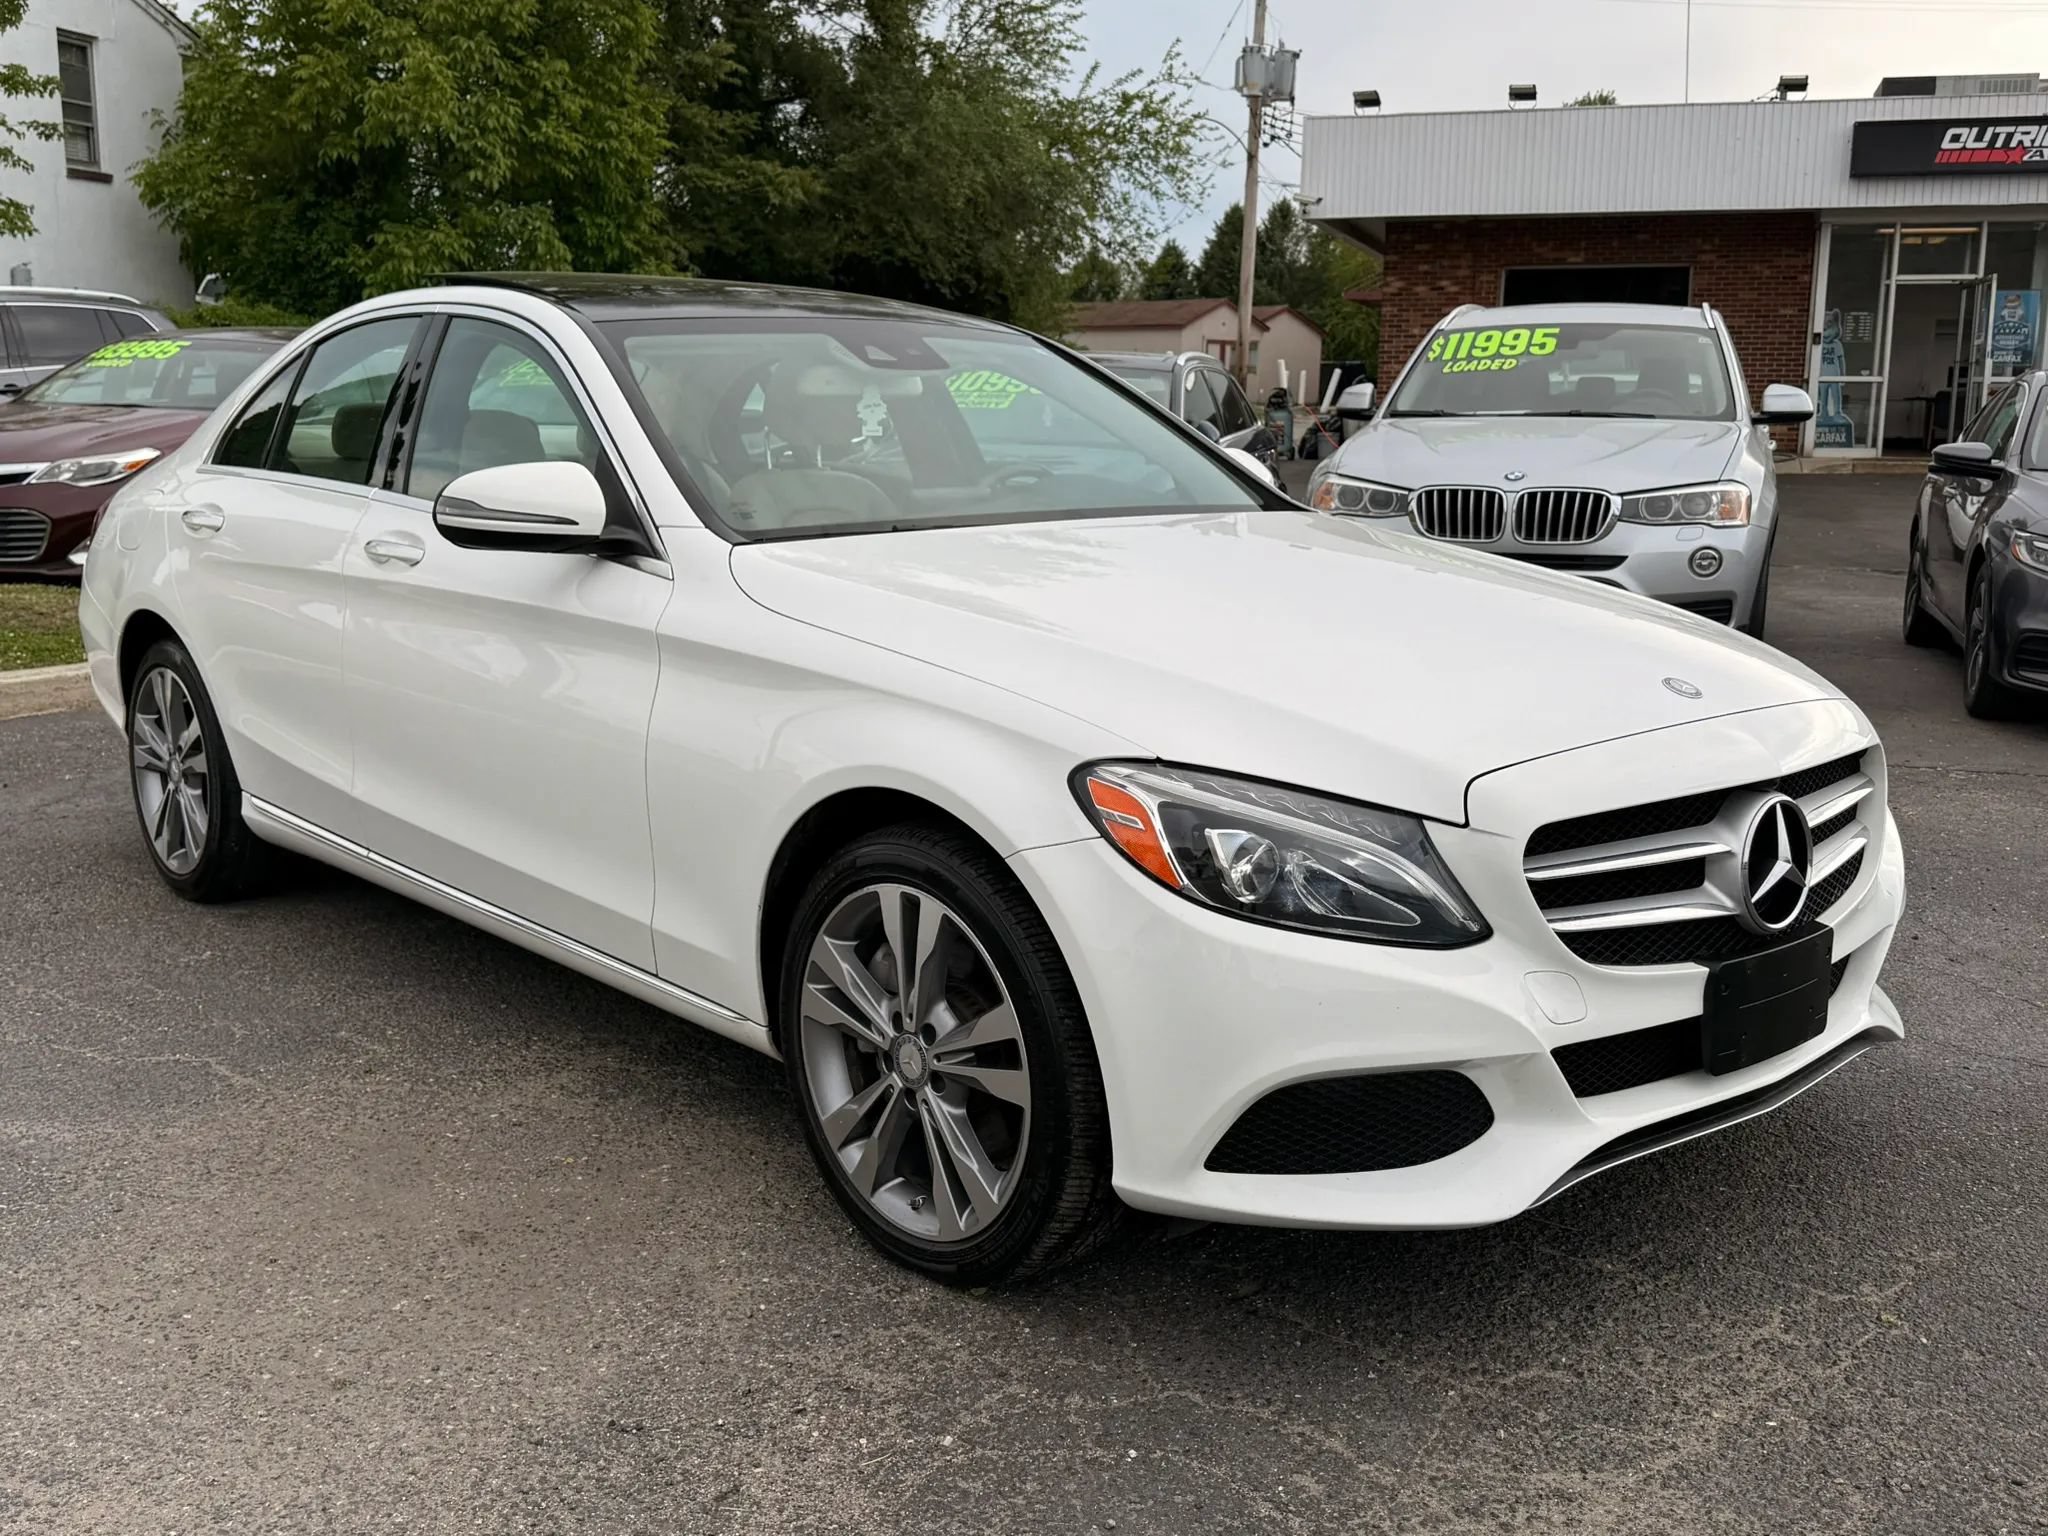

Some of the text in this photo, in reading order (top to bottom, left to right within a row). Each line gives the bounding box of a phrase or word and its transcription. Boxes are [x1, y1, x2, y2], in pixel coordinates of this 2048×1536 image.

[1428, 328, 1560, 361] $11995
[1442, 358, 1518, 374] LOADED
[1815, 432, 1847, 443] CARFAX
